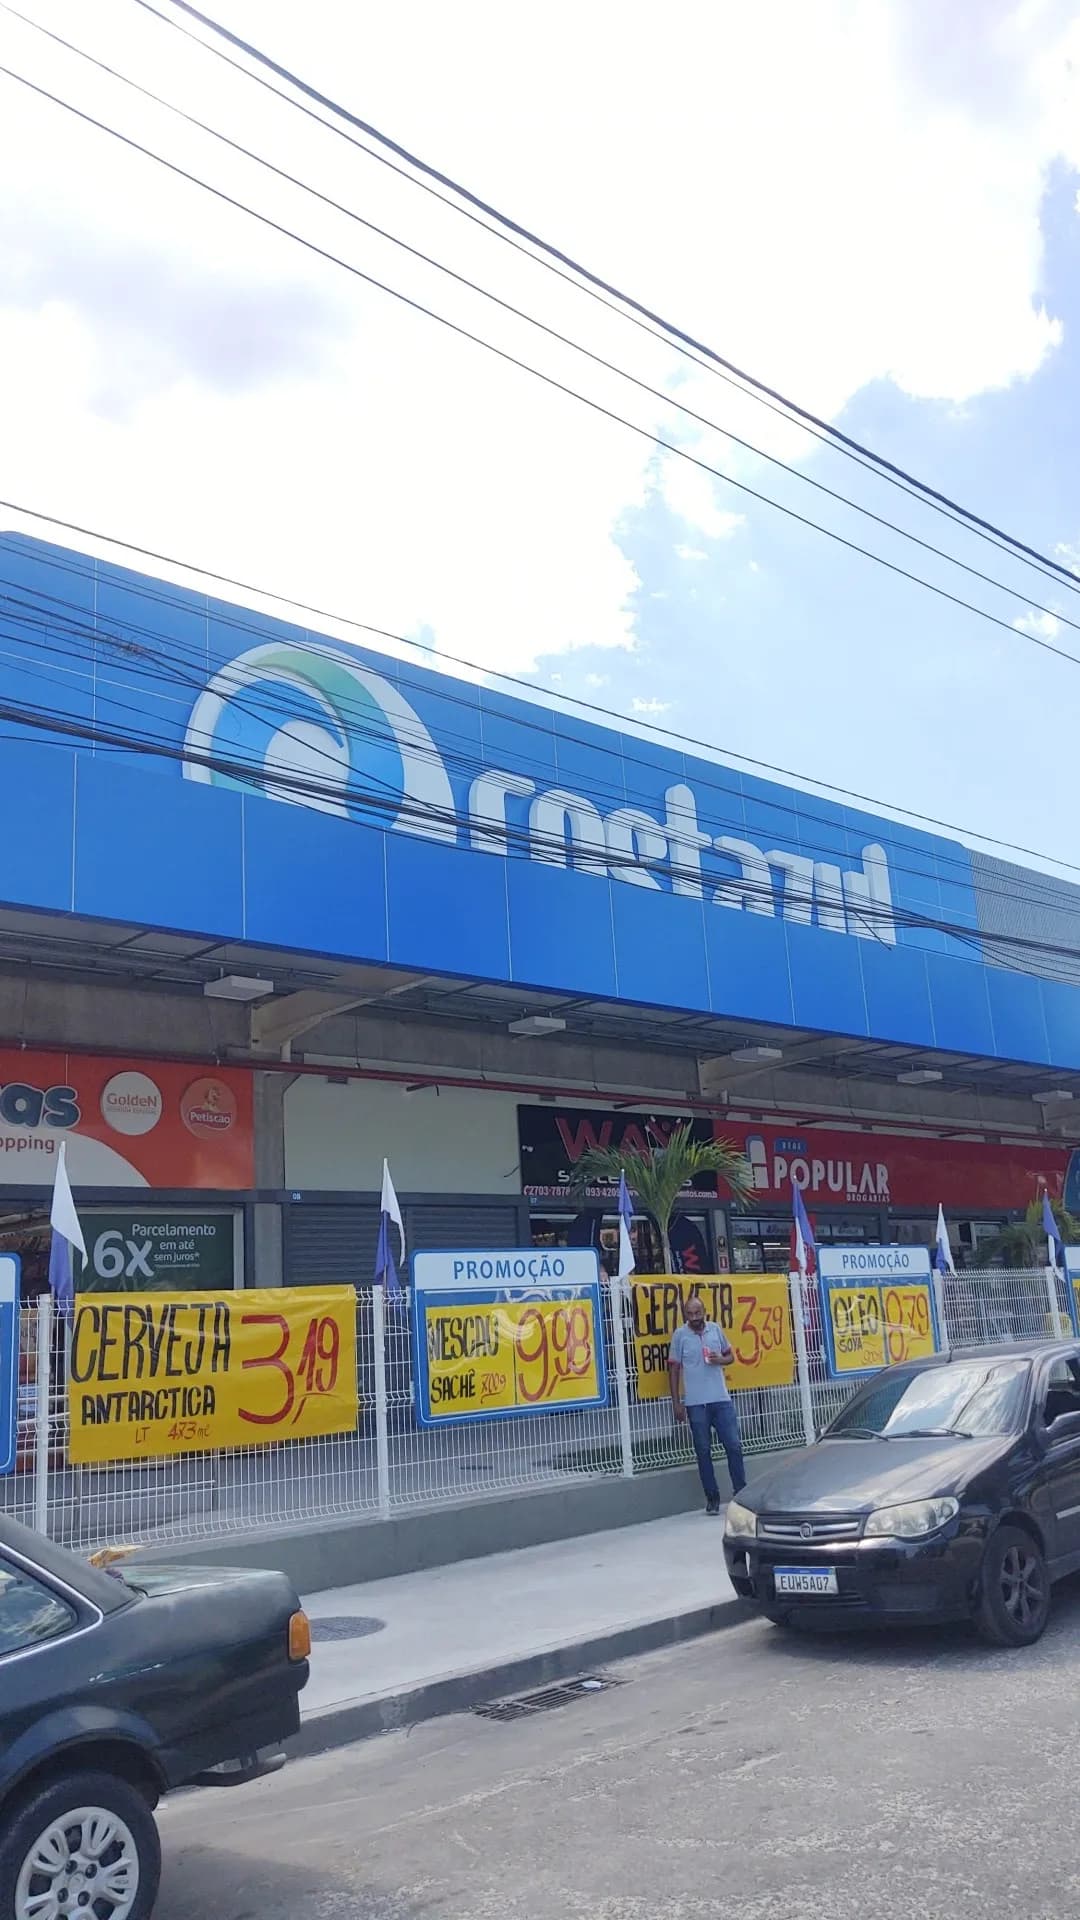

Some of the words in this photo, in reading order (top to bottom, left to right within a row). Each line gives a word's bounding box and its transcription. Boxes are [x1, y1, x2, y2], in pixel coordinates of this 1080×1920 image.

[0, 1082, 81, 1128] as
[774, 1155, 890, 1194] POPULAR
[132, 1223, 216, 1236] Parcelamento
[159, 1240, 176, 1250] em
[178, 1238, 195, 1250] até
[154, 1252, 172, 1261] sem
[454, 1255, 565, 1283] PROMOÇÃO
[842, 1251, 910, 1272] PROMOÇÃO
[71, 1302, 231, 1383] CERVEJA
[428, 1315, 499, 1362] NESCAU
[431, 1369, 476, 1404] SACHÊ
[81, 1385, 216, 1426] ANTARCTICA
